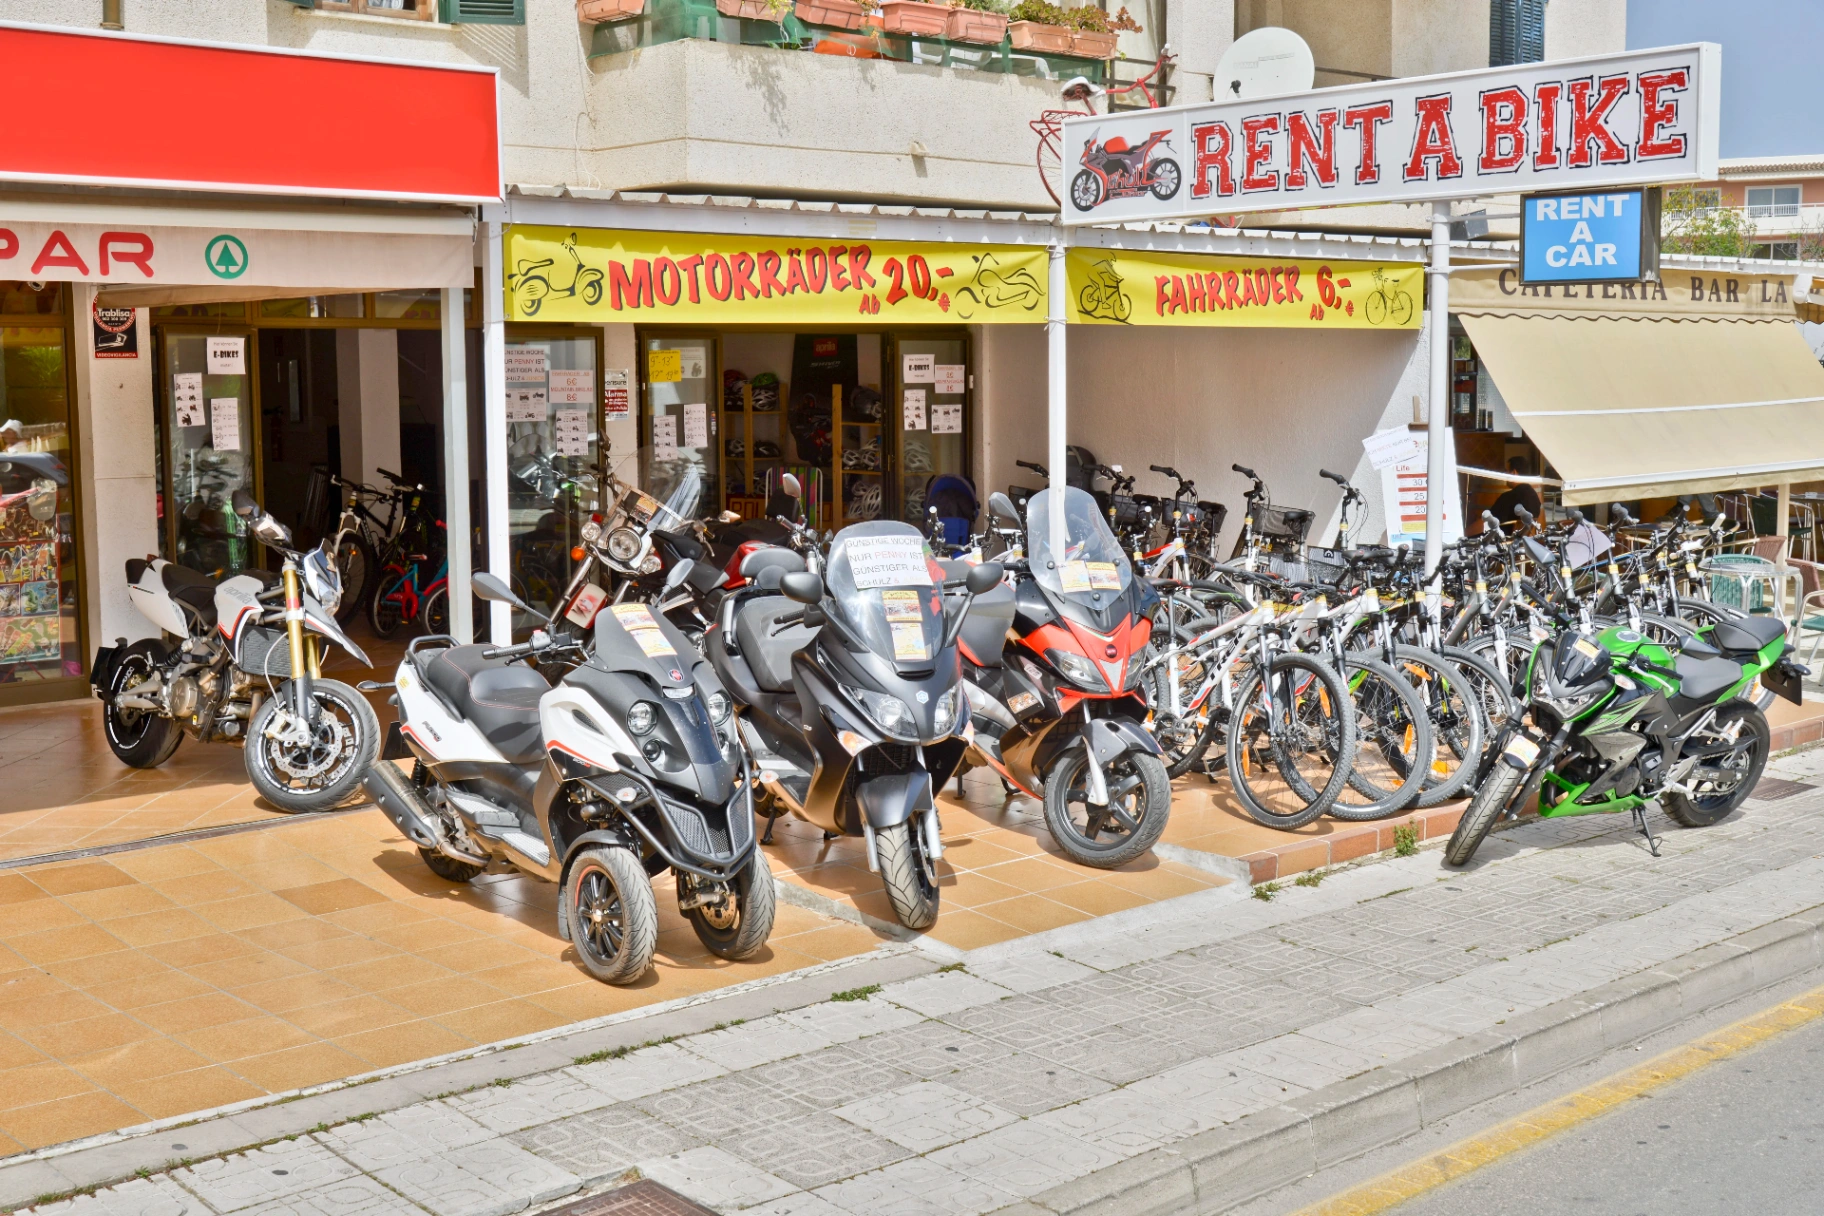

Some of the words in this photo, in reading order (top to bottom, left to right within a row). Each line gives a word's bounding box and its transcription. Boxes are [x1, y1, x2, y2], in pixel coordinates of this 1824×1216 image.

[1190, 99, 1394, 198] RENT
[1402, 91, 1464, 183] A
[1477, 64, 1692, 176] BIKE
[1535, 194, 1630, 221] RENT
[1569, 221, 1594, 243] A
[1545, 243, 1618, 268] CAR
[608, 244, 877, 311] MOTORRÄDER
[1155, 265, 1304, 317] FAHRRÄDER
[1690, 276, 1739, 303] BAR
[1761, 279, 1787, 303] LA
[213, 350, 239, 359] E-BIKES
[566, 378, 578, 386] 6€
[845, 537, 890, 548] GÜNSTIGE
[890, 537, 922, 546] WOCHE
[848, 552, 873, 562] NUR
[874, 551, 908, 560] PENNY
[909, 551, 923, 560] IST
[852, 563, 909, 576] GÜNSTIGER
[912, 564, 928, 573] ALS
[856, 577, 891, 587] SCHULZ
[223, 586, 252, 604] aprilia
